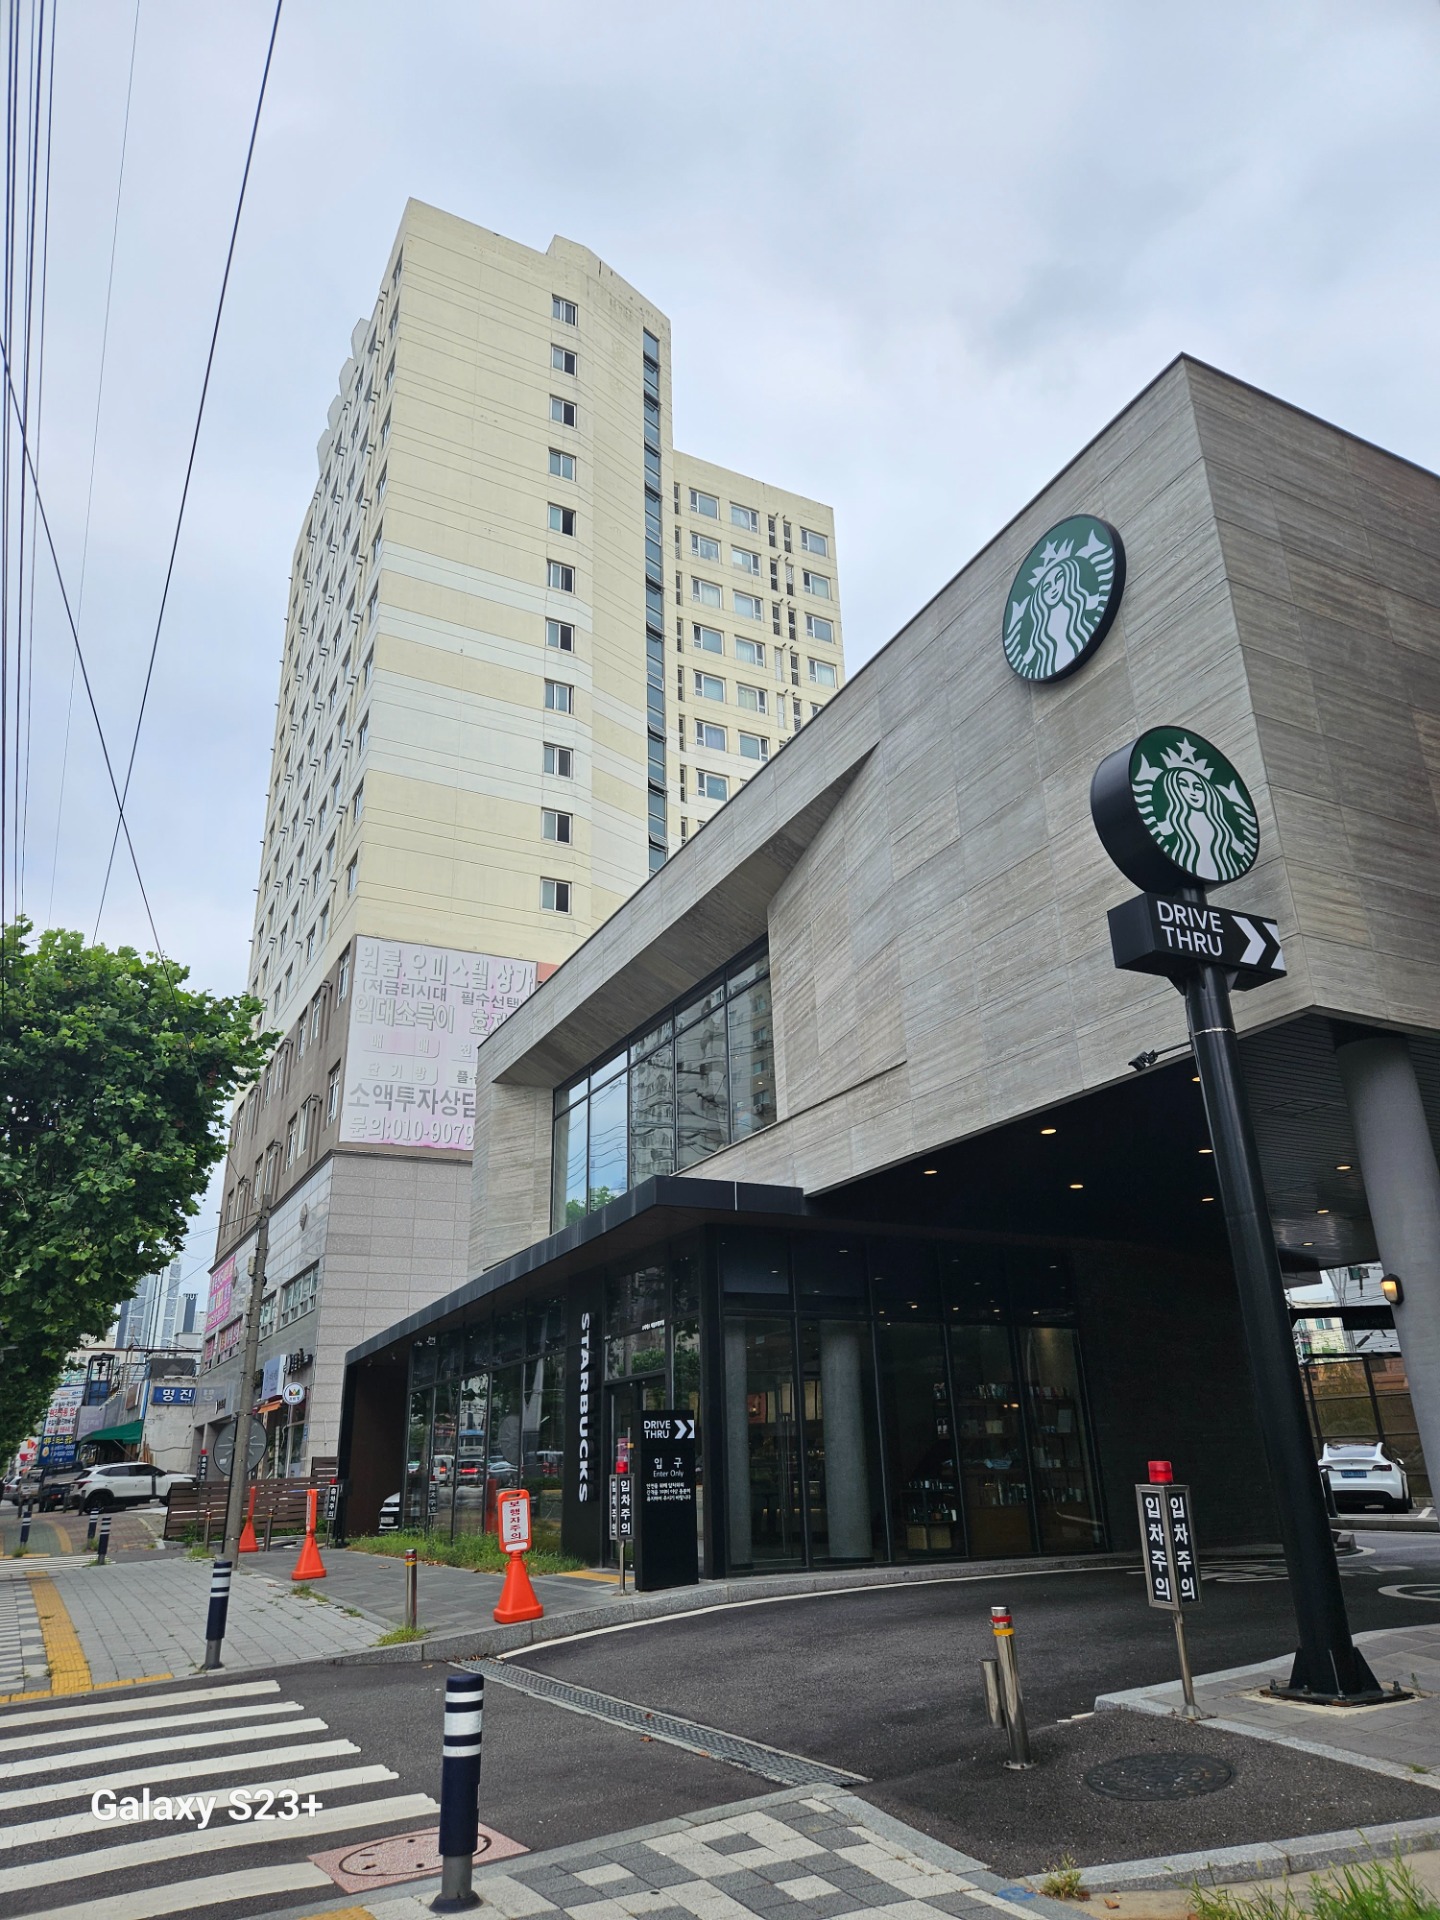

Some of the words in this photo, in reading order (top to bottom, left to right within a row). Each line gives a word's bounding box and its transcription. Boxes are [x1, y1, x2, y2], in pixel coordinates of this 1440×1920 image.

[1157, 901, 1224, 933] DRIVE
[1161, 925, 1223, 956] THRU
[355, 994, 455, 1034] 임대소득이
[579, 1312, 591, 1503] STARBUCKS
[643, 1420, 671, 1430] DRIVE
[644, 1430, 670, 1439] THRU
[653, 1470, 669, 1478] Enter
[670, 1470, 684, 1478] Only
[508, 1501, 522, 1540] 보행자주의
[620, 1480, 631, 1535] 입차주의
[1145, 1497, 1171, 1600] 입차주의
[1170, 1496, 1195, 1600] 입차주의
